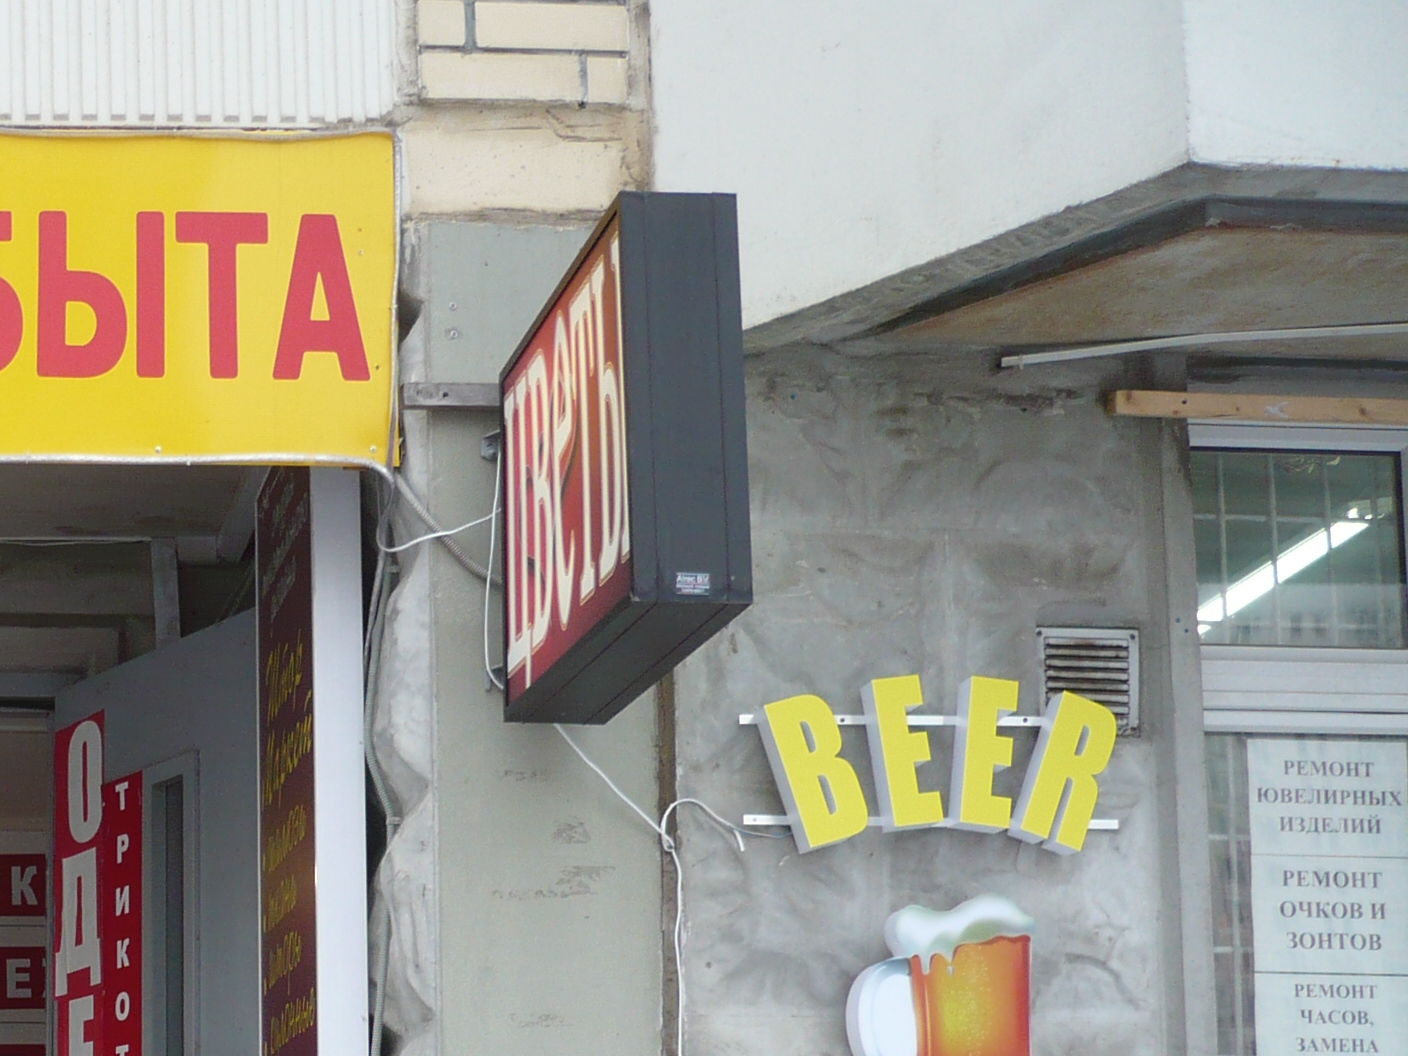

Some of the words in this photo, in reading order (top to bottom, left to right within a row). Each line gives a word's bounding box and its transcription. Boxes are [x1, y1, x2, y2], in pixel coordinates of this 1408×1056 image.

[763, 675, 1118, 853] BEER
[1283, 760, 1375, 779] РЕМОНТ
[1257, 787, 1403, 807] ЮВЕЛИРНЫХ
[1279, 815, 1382, 835] ИЗДЕЛИЙ
[1282, 870, 1383, 889] РЕМОНТ
[1279, 900, 1364, 920] ОЧКОВ
[1370, 902, 1387, 921] И
[1286, 931, 1383, 951] ЗОНТОВ
[1294, 983, 1378, 999] РЕМОНТ
[1300, 1009, 1375, 1027] ЧАСОВ,
[1295, 1038, 1379, 1054] ЗАМЕНА
